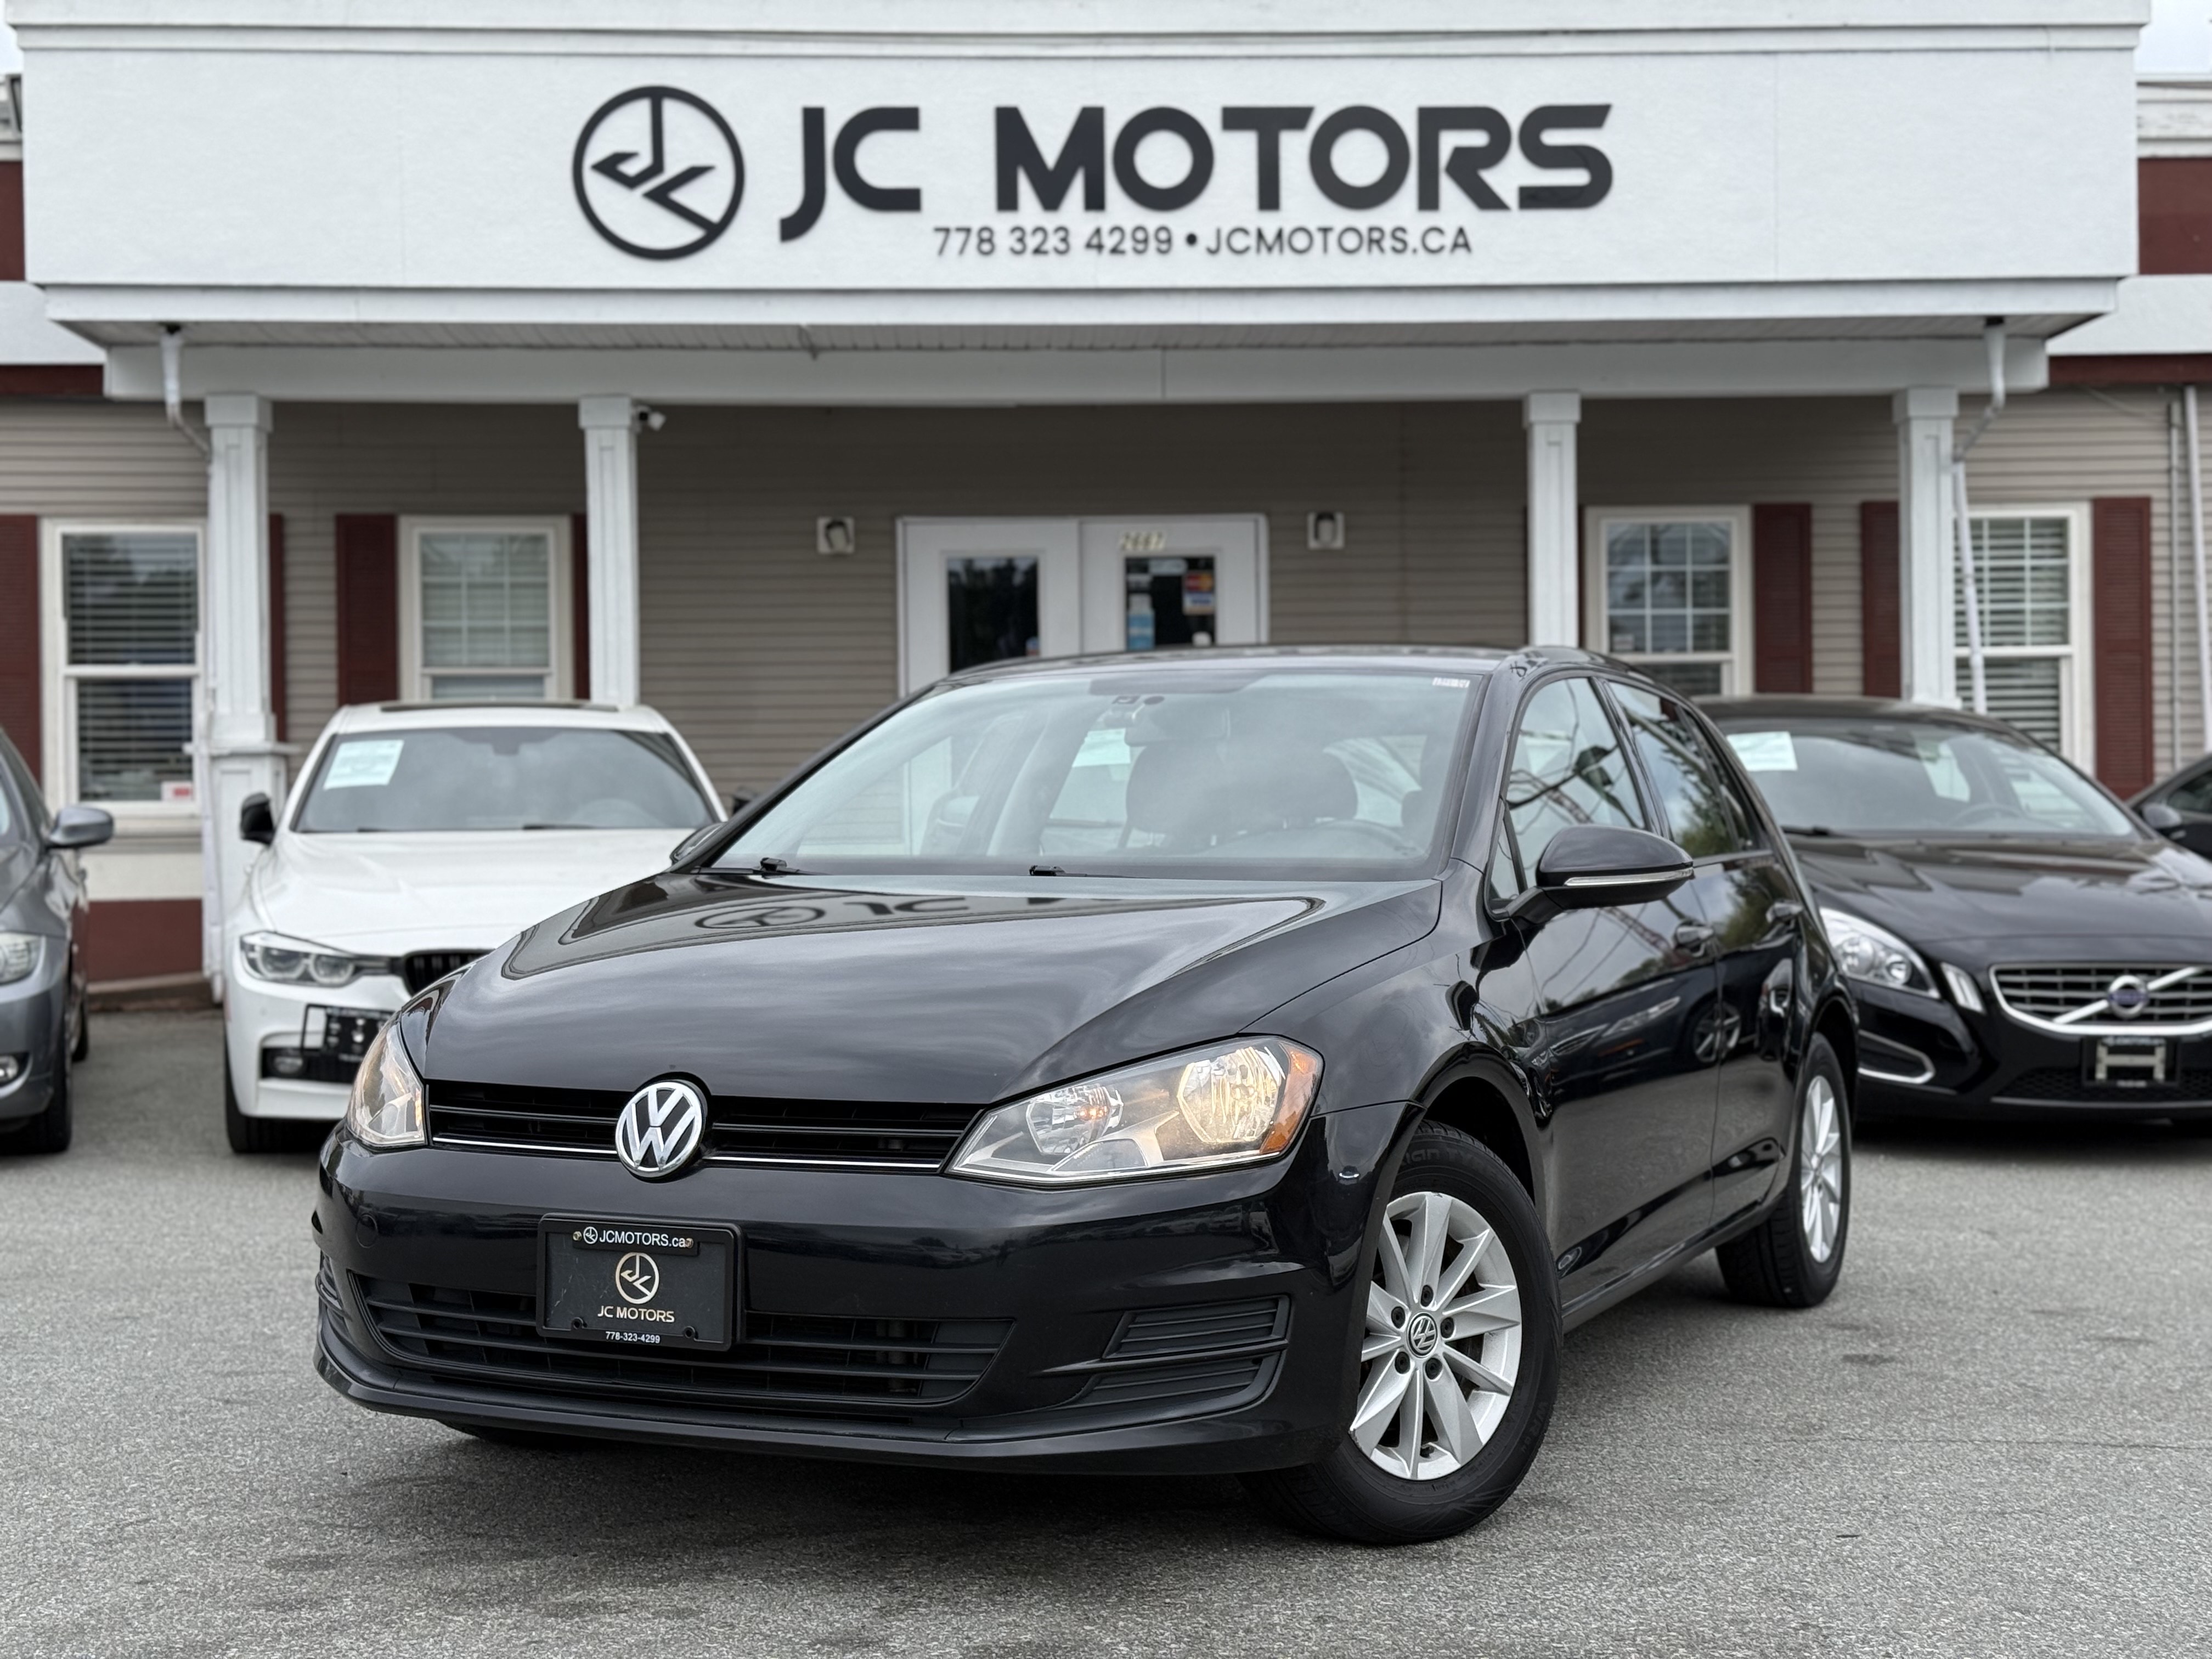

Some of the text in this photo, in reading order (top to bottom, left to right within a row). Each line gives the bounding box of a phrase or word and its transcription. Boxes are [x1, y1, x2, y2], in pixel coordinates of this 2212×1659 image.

[779, 103, 1613, 243] JC MOTORS
[934, 225, 1472, 256] 778 323 4299 JCMOTORS.CA
[599, 1229, 686, 1248] JCMOTORS.ca
[597, 1305, 675, 1323] JC MOTORS
[605, 1331, 661, 1344] 778-323-4299
